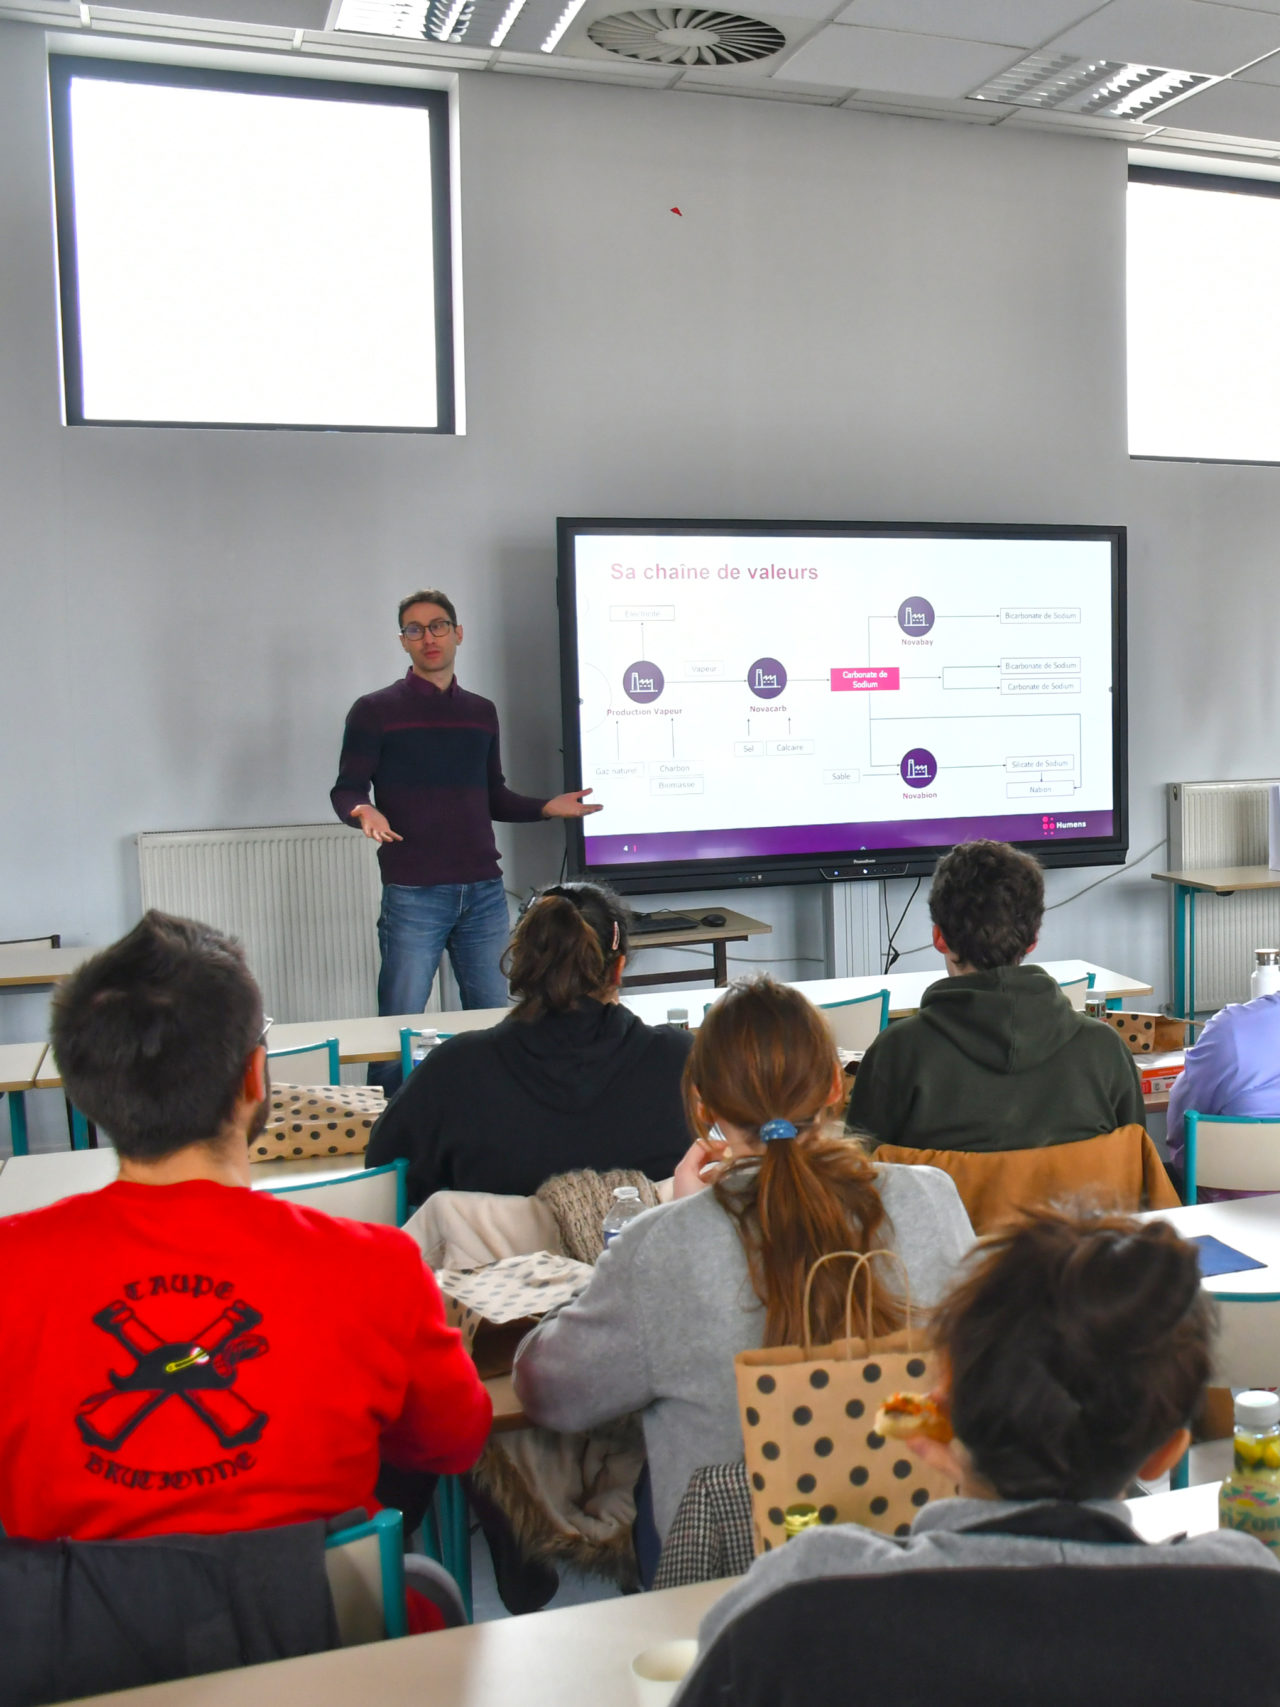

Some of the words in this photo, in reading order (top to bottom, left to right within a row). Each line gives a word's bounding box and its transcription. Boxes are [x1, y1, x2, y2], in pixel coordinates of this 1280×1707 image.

[610, 563, 636, 580] Sa
[643, 563, 710, 580] chaîne
[717, 563, 741, 580] de
[747, 563, 819, 580] valeurs
[901, 638, 934, 646] Novabay
[1005, 662, 1043, 670] Bicarbonate
[1045, 661, 1052, 669] de
[1053, 661, 1077, 669] Sodium
[842, 670, 877, 679] Carbonate
[879, 670, 888, 679] de
[852, 680, 878, 689] Sodium
[1007, 683, 1040, 691] Carbonate
[1042, 682, 1050, 690] de
[1051, 682, 1074, 690] Sodium
[606, 707, 652, 717] Production
[653, 707, 683, 718] Vapeur
[749, 704, 787, 713] Novacarb
[743, 745, 755, 753] Sel
[776, 743, 803, 752] Calcaire
[1035, 759, 1044, 768] de
[1045, 758, 1069, 767] Sodium
[659, 764, 690, 772] Charbon
[831, 772, 851, 781] Sable
[902, 791, 938, 800] Novabion
[1056, 820, 1087, 829] Humens
[123, 1274, 236, 1300] TAUPE
